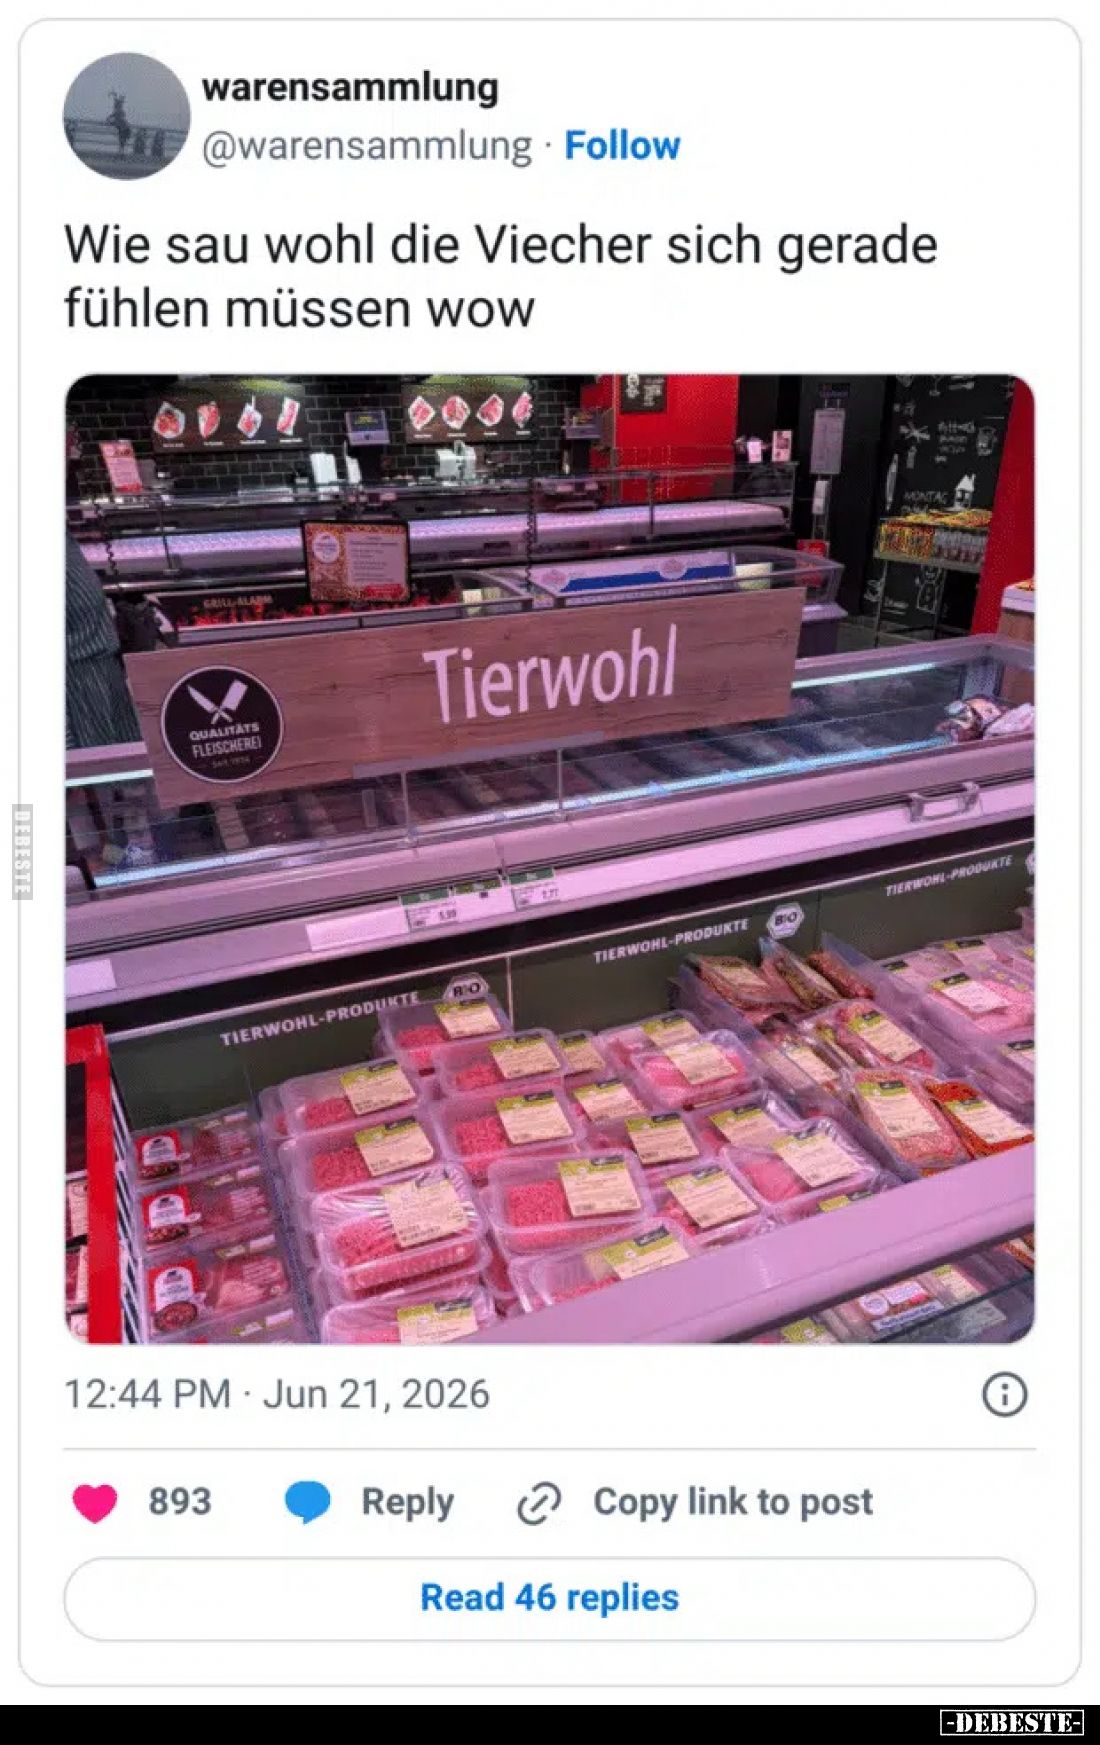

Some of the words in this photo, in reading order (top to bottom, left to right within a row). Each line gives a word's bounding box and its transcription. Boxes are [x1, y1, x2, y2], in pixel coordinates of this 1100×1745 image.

[422, 623, 677, 723] Tierwohl
[192, 735, 262, 758] FLEISCHEREI
[884, 854, 1013, 897] TIERWOHL-PRODUKTE
[775, 911, 797, 926] BIO
[593, 918, 749, 964] TIERWOHL-PRODUKTE
[220, 991, 419, 1047] TIERWOHL-PRODUKTE
